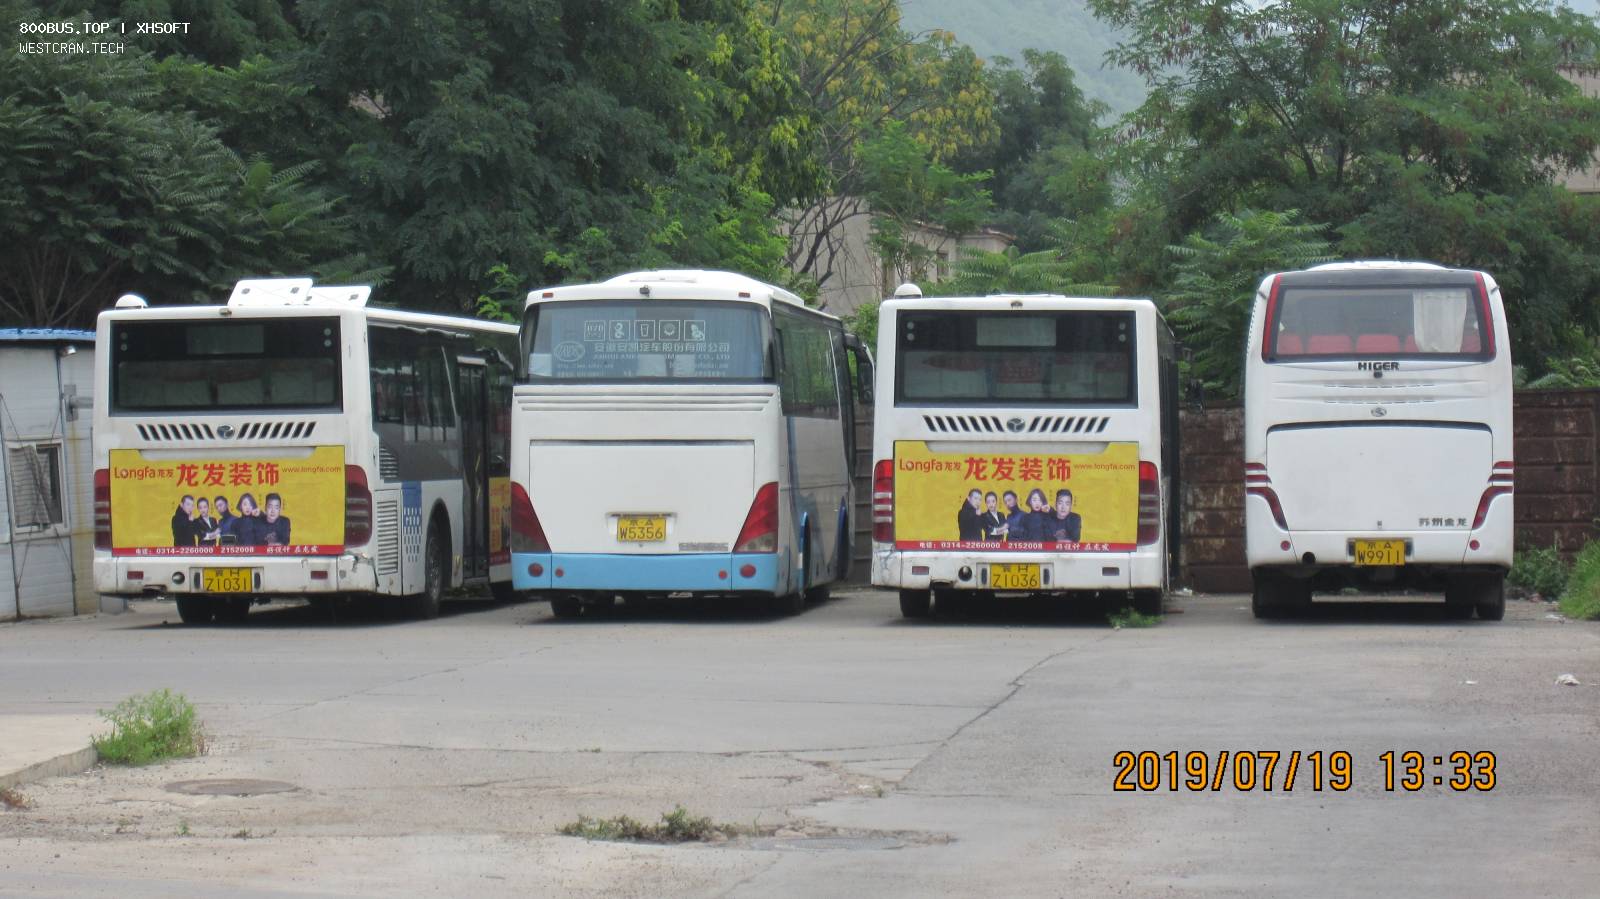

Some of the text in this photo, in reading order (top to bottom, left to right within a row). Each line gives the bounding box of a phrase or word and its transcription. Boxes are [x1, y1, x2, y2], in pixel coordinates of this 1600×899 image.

[1357, 361, 1400, 371] HIGER
[281, 466, 342, 474] www.longfa.com
[899, 458, 943, 473] Longfa
[964, 457, 1071, 482] 龙发装饰
[1073, 463, 1136, 471] www.longfa.com
[114, 466, 156, 480] Longfa
[176, 462, 280, 487] 龙发装饰
[1419, 517, 1468, 527] 苏州金龙
[619, 527, 663, 540] W5356
[1358, 550, 1400, 563] W9911
[205, 577, 247, 591] Z1031
[993, 574, 1038, 588] Z1036
